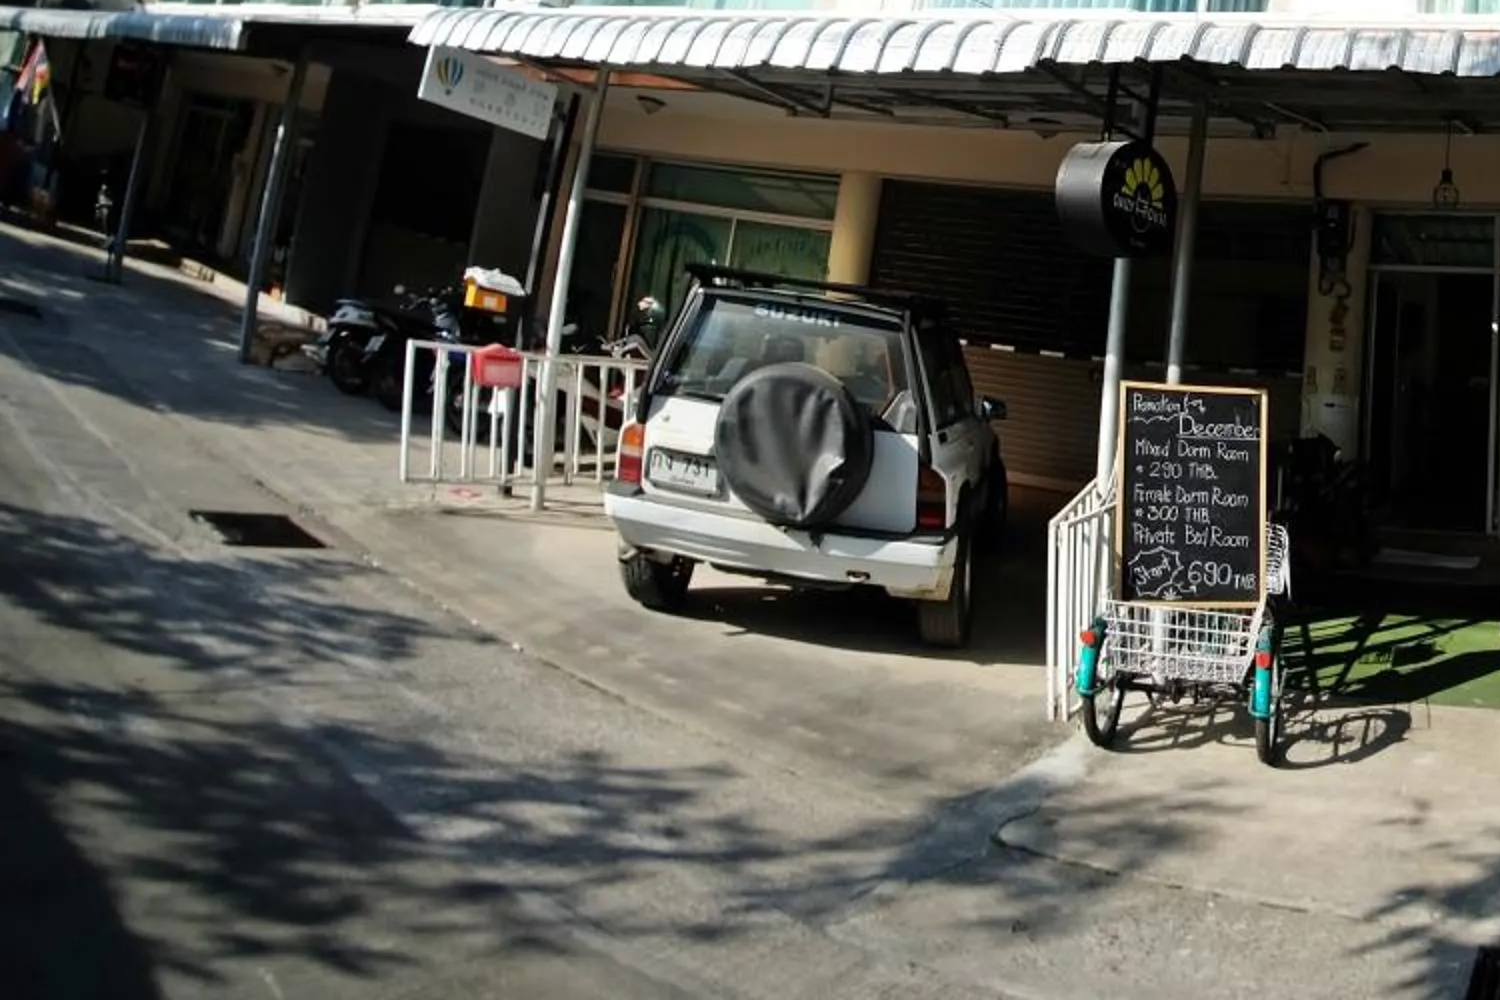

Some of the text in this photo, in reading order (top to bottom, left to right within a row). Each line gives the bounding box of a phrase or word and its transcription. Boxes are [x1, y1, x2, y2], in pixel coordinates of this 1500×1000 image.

[754, 303, 840, 328] SUZUKI
[1178, 412, 1261, 440] December
[1178, 440, 1211, 458] Dorm
[1217, 441, 1249, 462] Room
[1149, 461, 1182, 479] 290
[1176, 485, 1209, 504] Dorm
[1211, 486, 1249, 508] Room
[1147, 505, 1179, 521] 300
[1210, 526, 1249, 547] Room
[1188, 560, 1231, 586] 690
